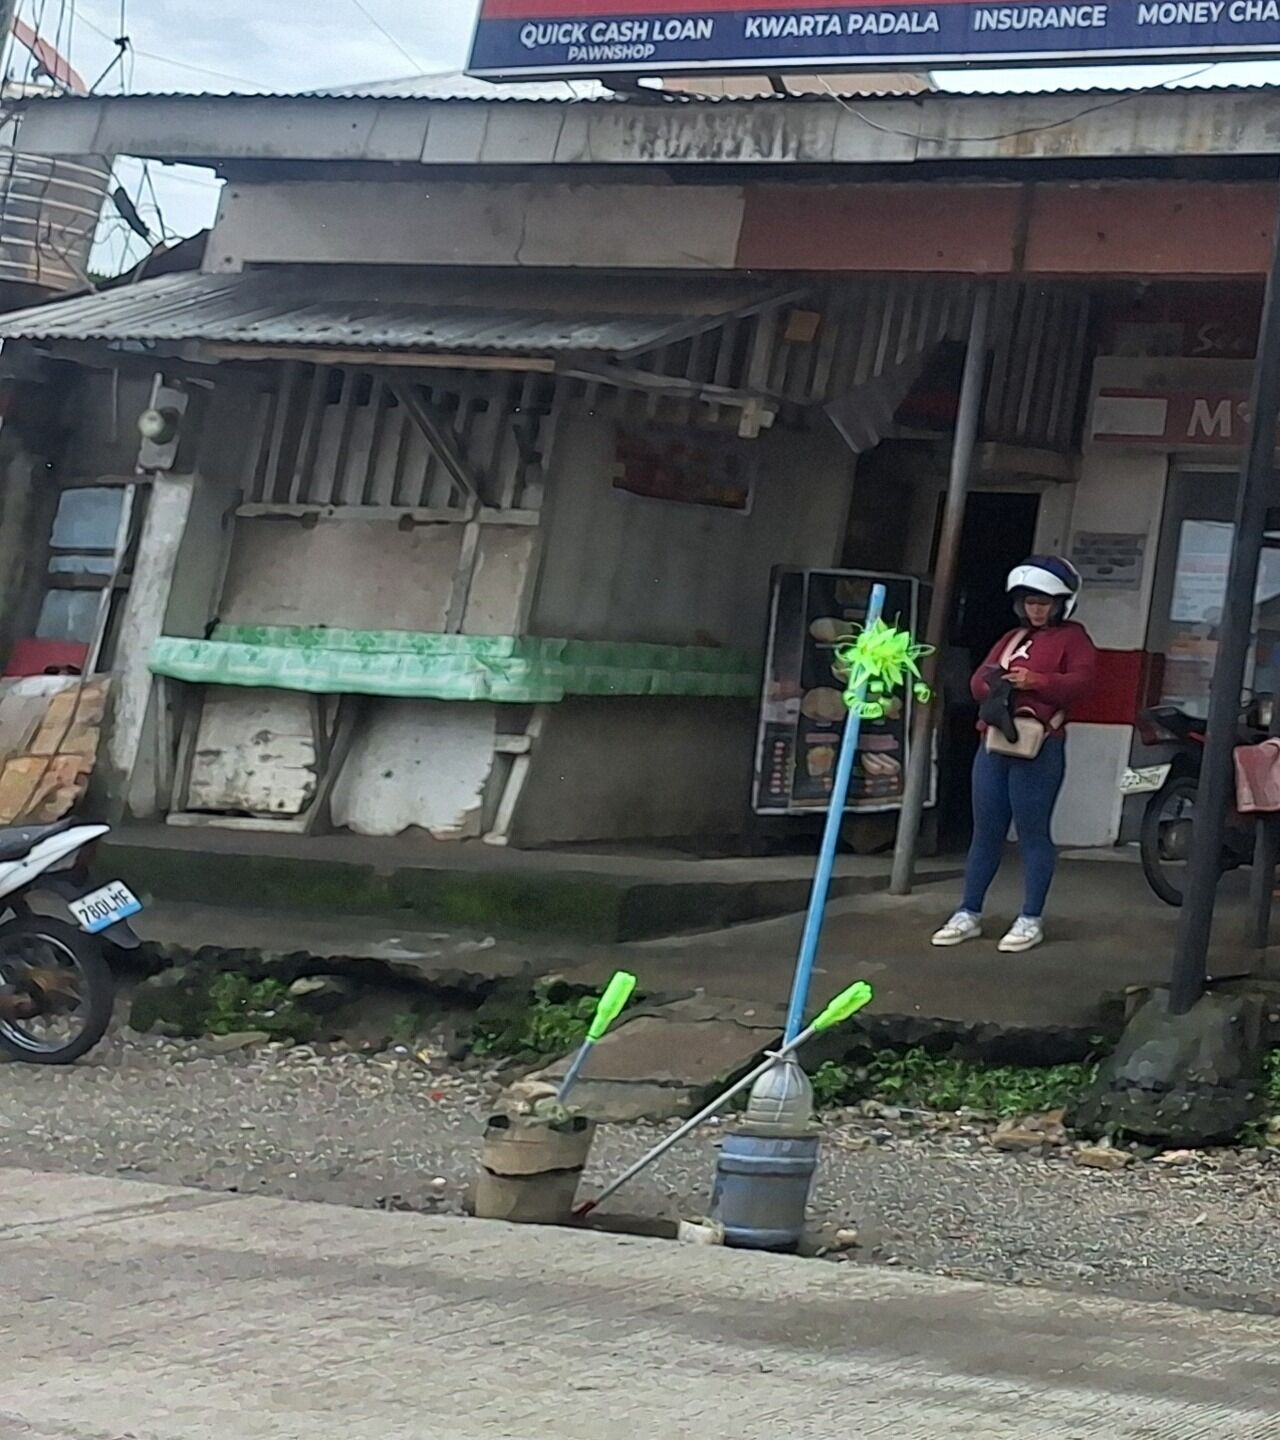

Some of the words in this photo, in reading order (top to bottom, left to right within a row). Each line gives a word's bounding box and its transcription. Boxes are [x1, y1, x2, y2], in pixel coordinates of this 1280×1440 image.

[520, 22, 586, 47] QUICK
[590, 20, 649, 44] CASH
[652, 18, 714, 41] LOAN
[745, 14, 842, 38] KWARTA
[847, 11, 940, 35] PADALA
[974, 5, 1108, 31] INSURANCE
[1137, 0, 1225, 25] MONEY
[567, 43, 655, 61] PAWNSHOP
